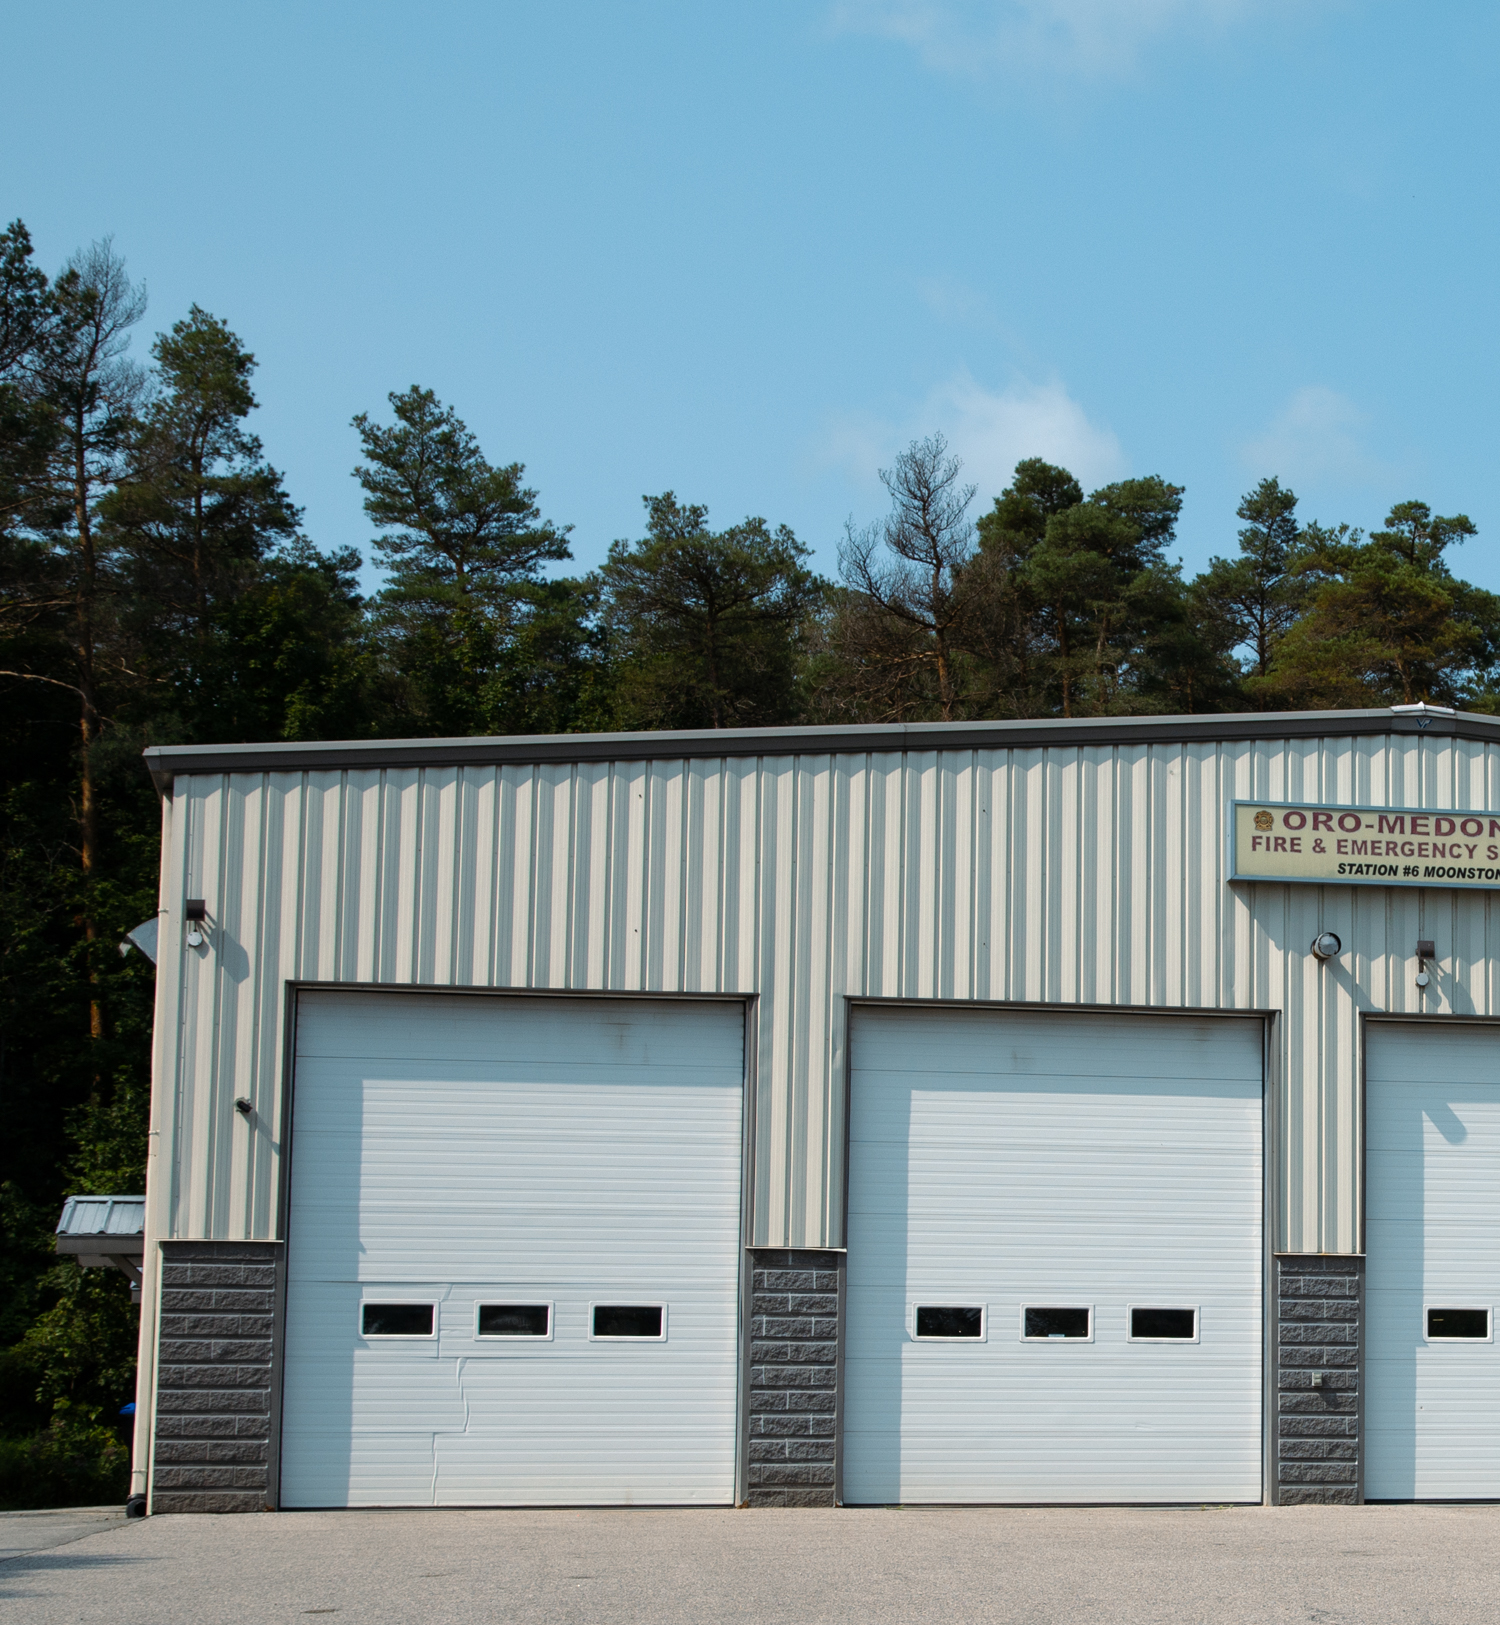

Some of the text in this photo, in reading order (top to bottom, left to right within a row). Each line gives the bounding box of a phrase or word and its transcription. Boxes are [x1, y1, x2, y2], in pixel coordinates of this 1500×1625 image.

[1252, 836, 1302, 853] FIRE
[1312, 838, 1326, 854] &
[1336, 839, 1478, 859] EMERGENCY
[1337, 863, 1398, 877] STATION
[1402, 866, 1419, 877] #6
